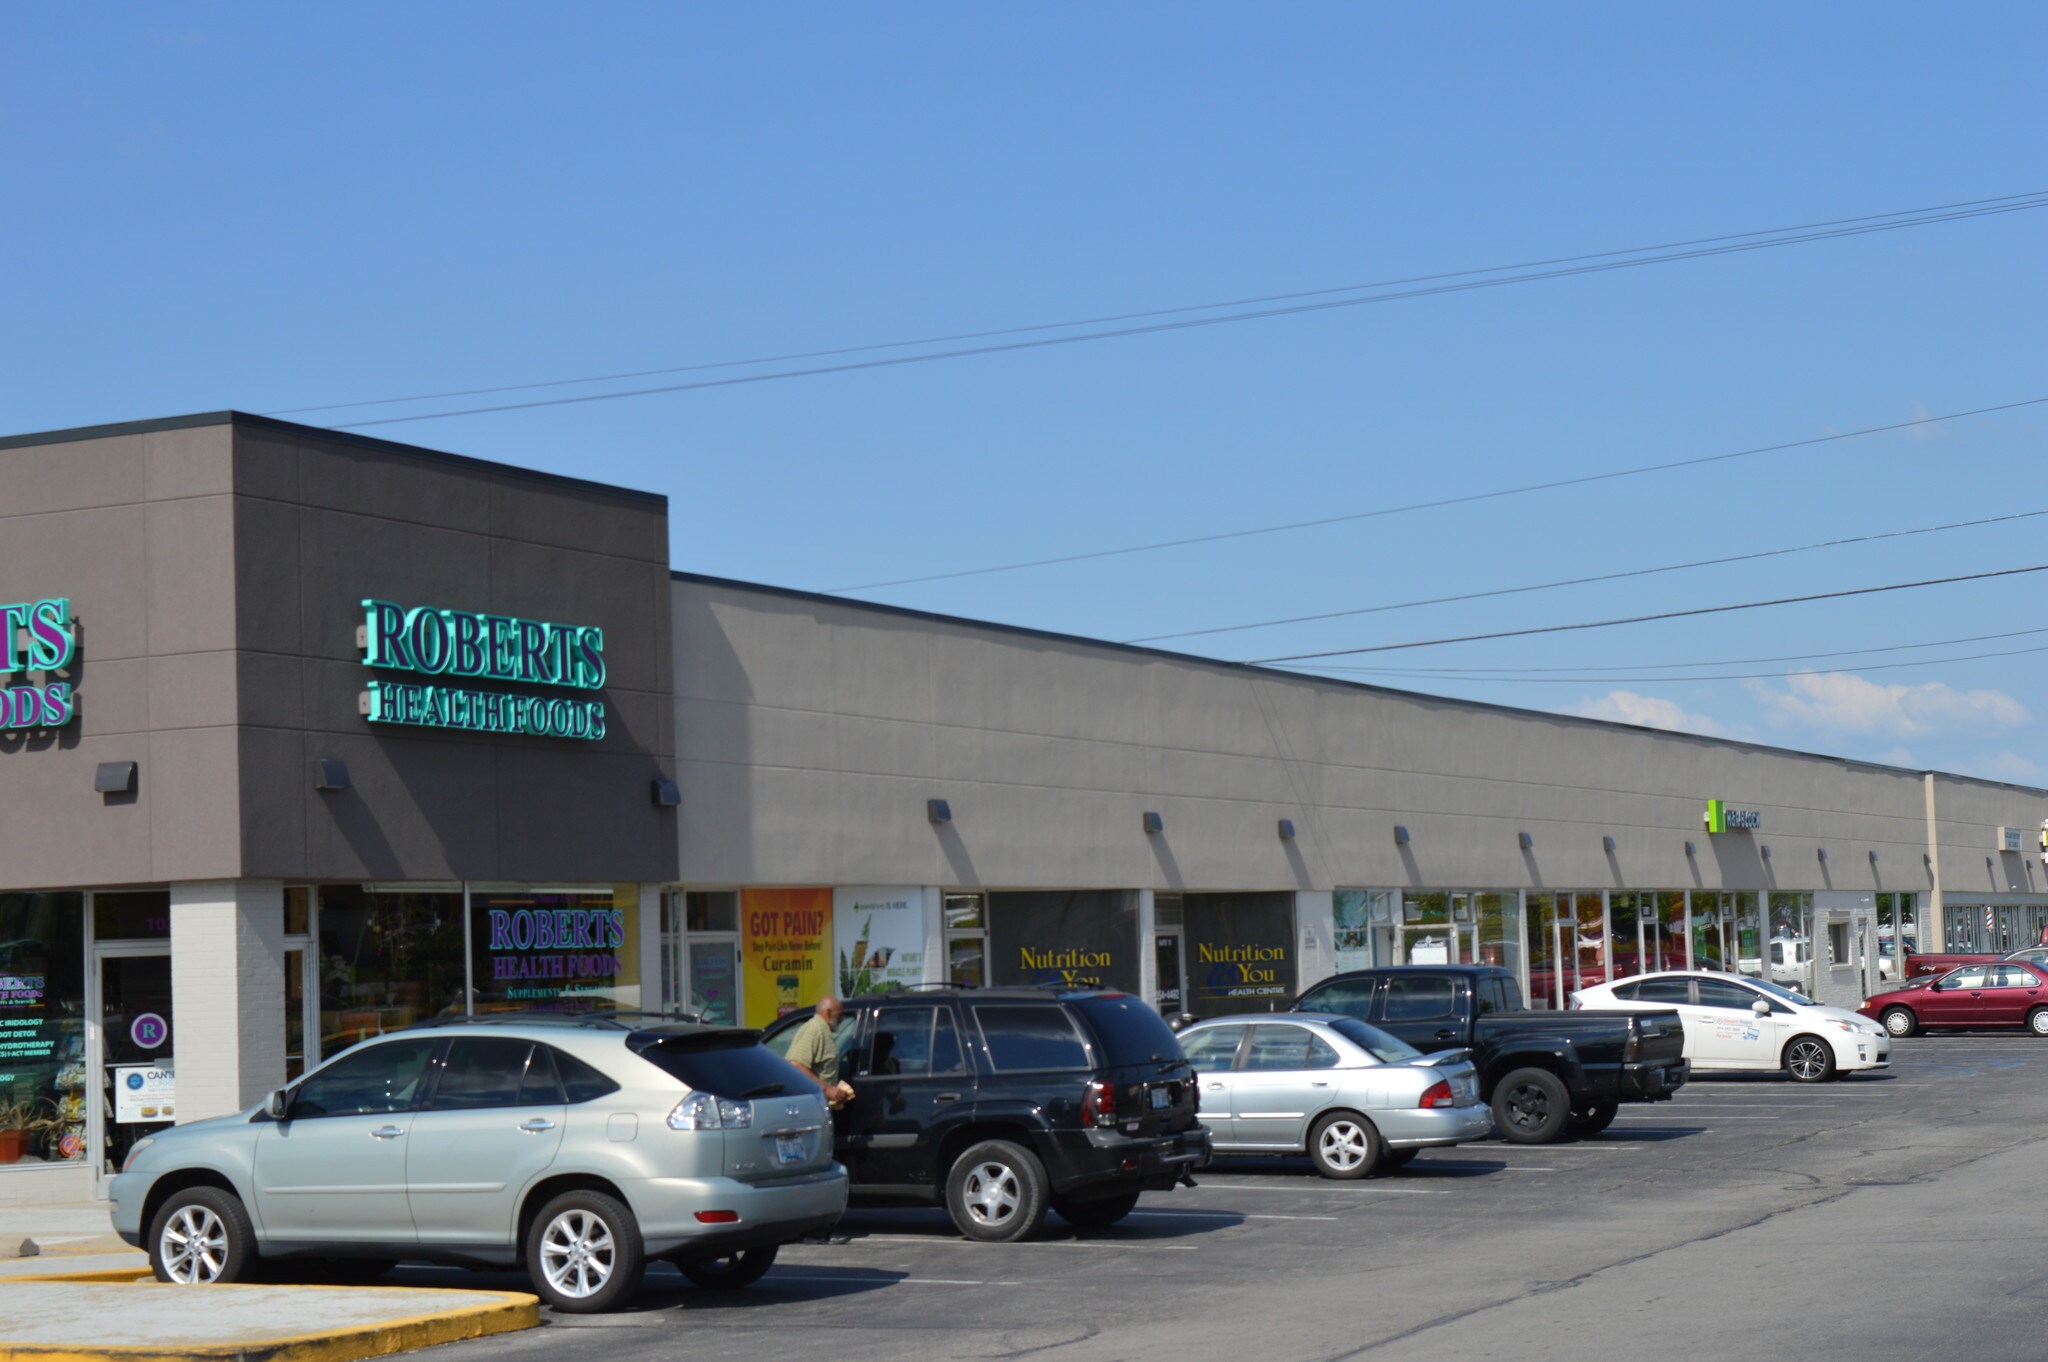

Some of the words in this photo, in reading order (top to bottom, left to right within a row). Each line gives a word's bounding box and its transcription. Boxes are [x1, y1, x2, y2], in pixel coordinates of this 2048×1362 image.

[361, 599, 606, 690] ROBERTS
[489, 909, 625, 950] ROBERTS
[751, 912, 779, 937] GOT
[784, 912, 824, 936] PAIN?
[1020, 946, 1112, 969] Nutrition
[1198, 943, 1285, 963] Nutrition
[493, 955, 564, 979] HEALTH
[568, 954, 623, 977] FOODS
[763, 955, 813, 971] Curamin
[1237, 963, 1275, 982] You
[1228, 988, 1255, 997] HEALTH
[5, 1018, 44, 1026] IRIDOLOGY
[142, 1022, 157, 1039] R
[13, 1030, 37, 1038] DETOX
